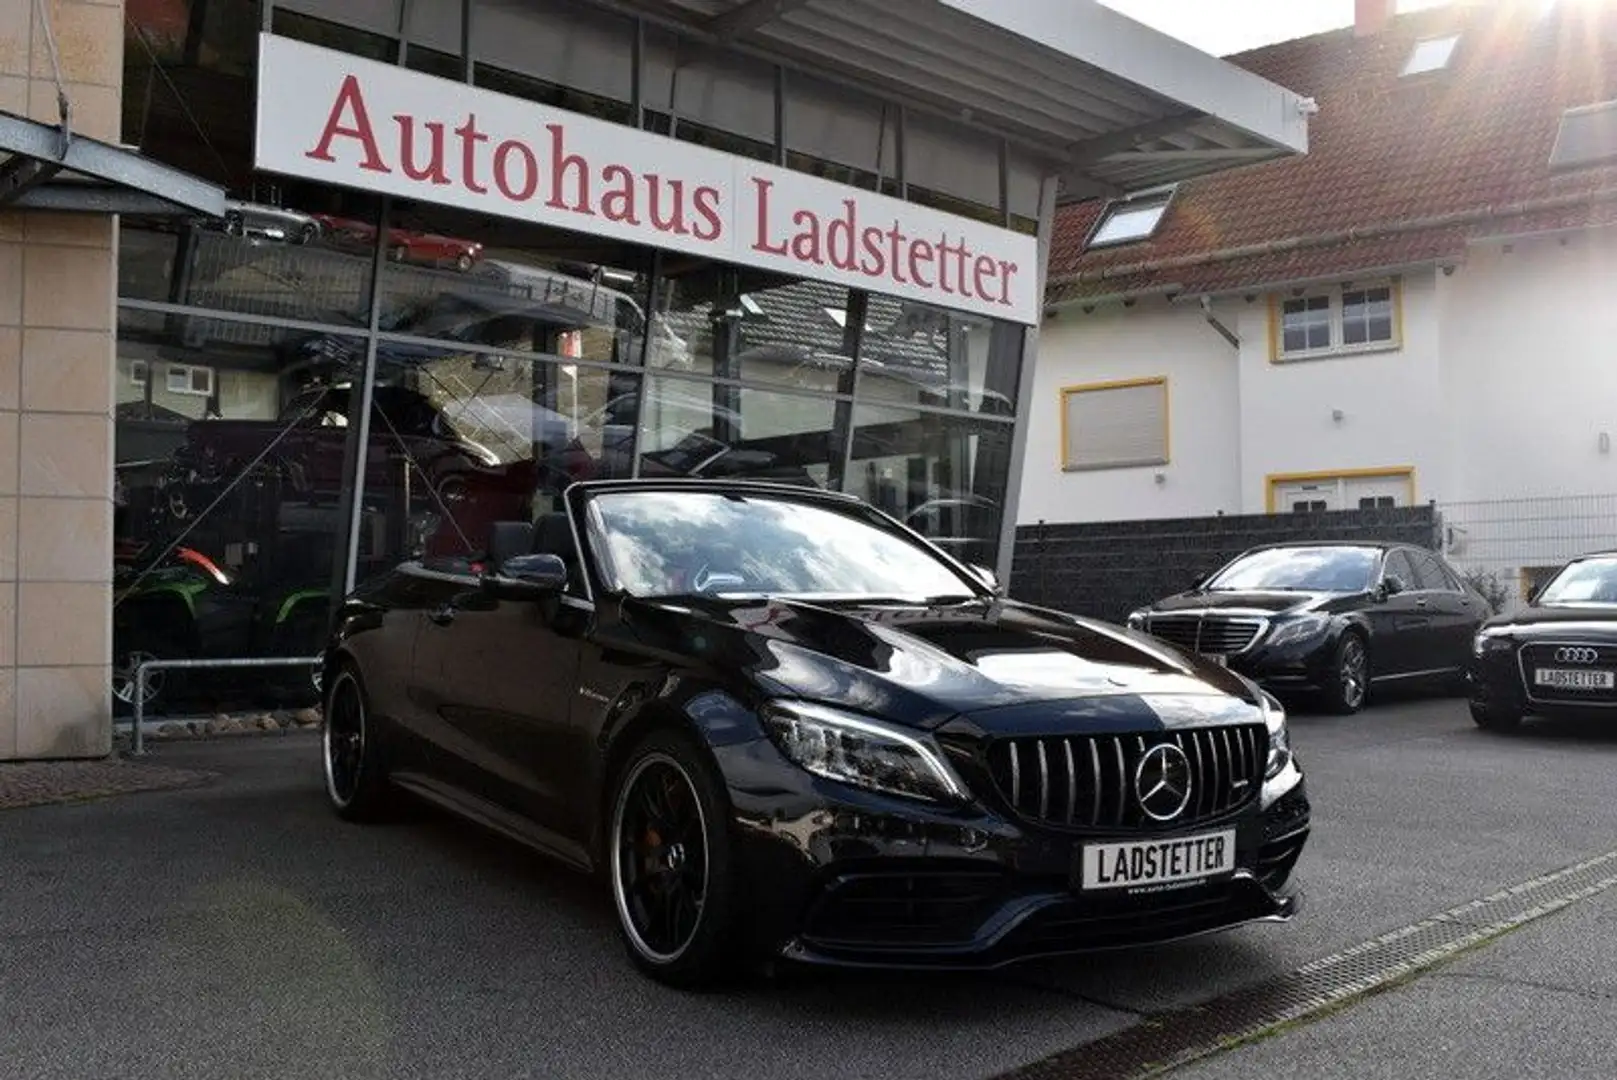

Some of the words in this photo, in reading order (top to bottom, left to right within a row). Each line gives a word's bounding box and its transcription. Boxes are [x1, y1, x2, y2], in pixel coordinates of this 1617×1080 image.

[306, 74, 722, 242] Autohaus
[752, 177, 1019, 307] Ladstetter
[1097, 836, 1224, 883] LADSTETTER
